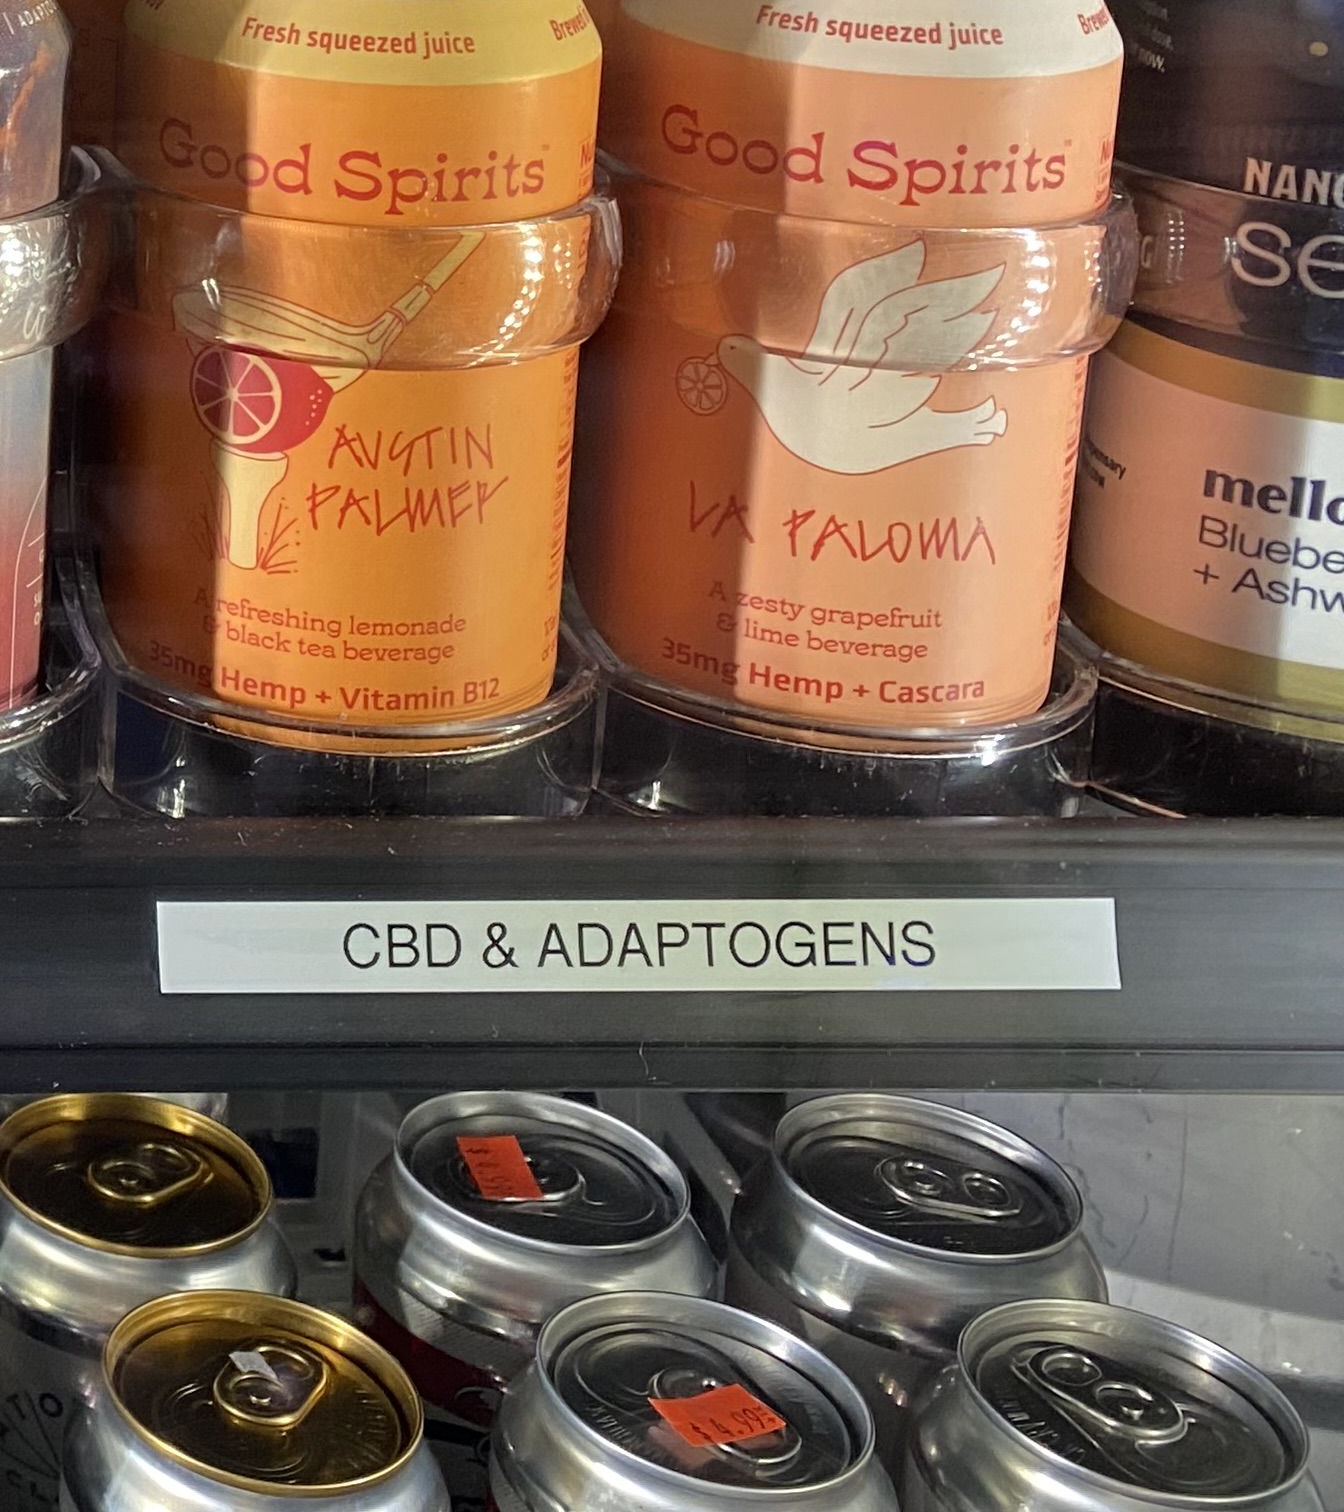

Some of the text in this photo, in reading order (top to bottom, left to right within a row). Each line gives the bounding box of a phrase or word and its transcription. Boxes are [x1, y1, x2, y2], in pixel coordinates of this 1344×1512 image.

[240, 16, 476, 60] Fresh squeezed juice
[756, 4, 1004, 51] Fresh squeezed juice
[159, 117, 311, 195] Good
[661, 103, 825, 184] Good
[306, 475, 509, 536] PALMER
[689, 480, 996, 566] LA PALOMA
[215, 594, 343, 637] refreshing
[348, 614, 467, 638] lemonade
[707, 580, 943, 632] A zesty grapefruit
[225, 621, 291, 653] black
[297, 638, 336, 659] tea
[342, 640, 455, 666] beverage
[743, 617, 799, 647] lime
[806, 630, 928, 662] beverage
[220, 660, 306, 707] Hemp
[314, 689, 333, 706] +
[339, 687, 455, 712] Vitamin
[462, 677, 501, 705] B12
[660, 638, 985, 703] 35mg Hemp + Cascara
[342, 919, 937, 970] CBD & ADAPTOGENS
